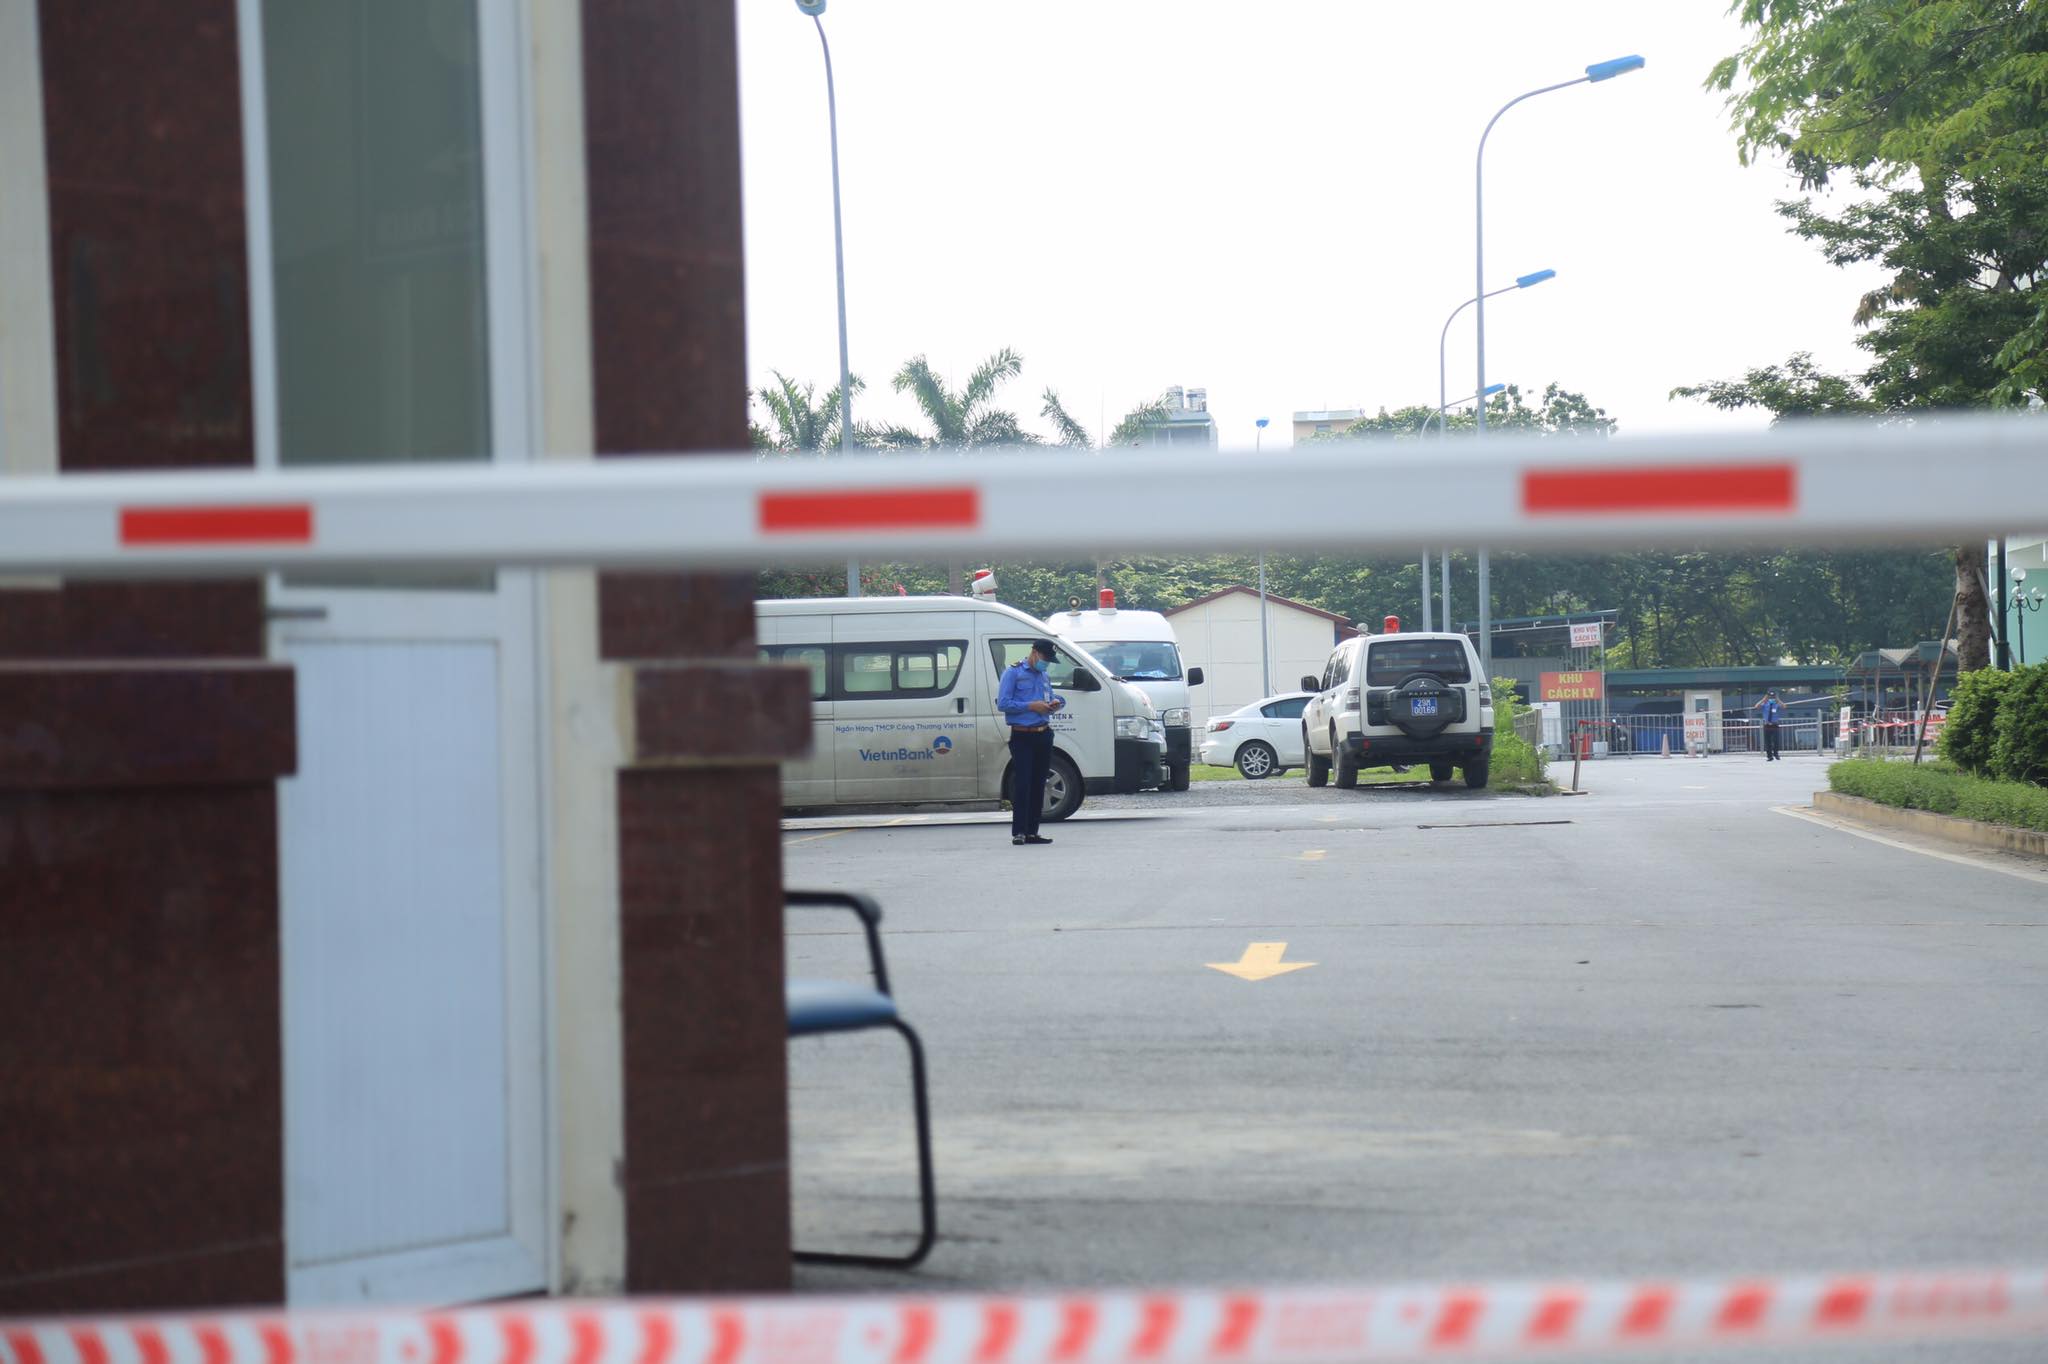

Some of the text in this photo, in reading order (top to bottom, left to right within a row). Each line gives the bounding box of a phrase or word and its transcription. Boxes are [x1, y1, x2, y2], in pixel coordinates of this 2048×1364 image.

[1558, 673, 1583, 684] KHU
[1547, 686, 1595, 699] CÁCH LY
[1414, 706, 1436, 714] 00169
[836, 724, 854, 733] Ngân
[896, 723, 915, 732] Công
[859, 747, 934, 761] VietinBank
